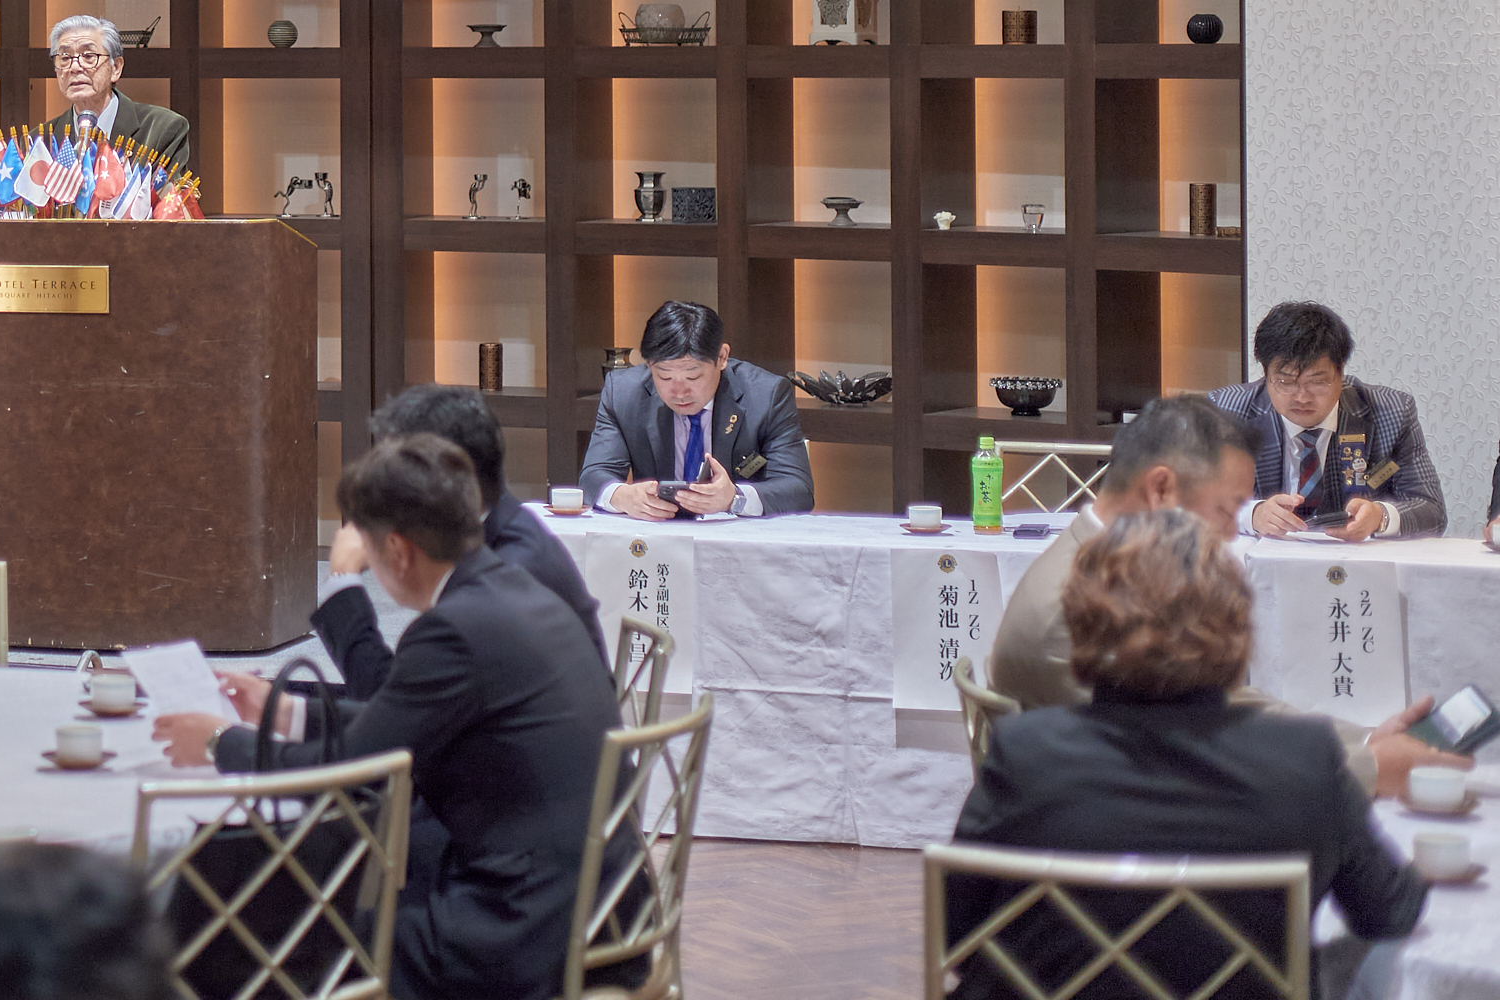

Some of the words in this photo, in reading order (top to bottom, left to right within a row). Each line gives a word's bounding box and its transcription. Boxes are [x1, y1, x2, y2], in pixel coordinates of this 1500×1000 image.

[32, 279, 96, 290] TERRACE
[628, 568, 649, 612] 鈴木
[656, 563, 670, 631] 第2副地区
[938, 585, 959, 628] 菊池
[968, 579, 979, 605] 1Z
[1360, 590, 1373, 616] 2Z
[969, 614, 980, 640] ZC
[1327, 598, 1351, 643] 永井
[1362, 627, 1375, 654] ZC
[1330, 652, 1354, 698] 大貴
